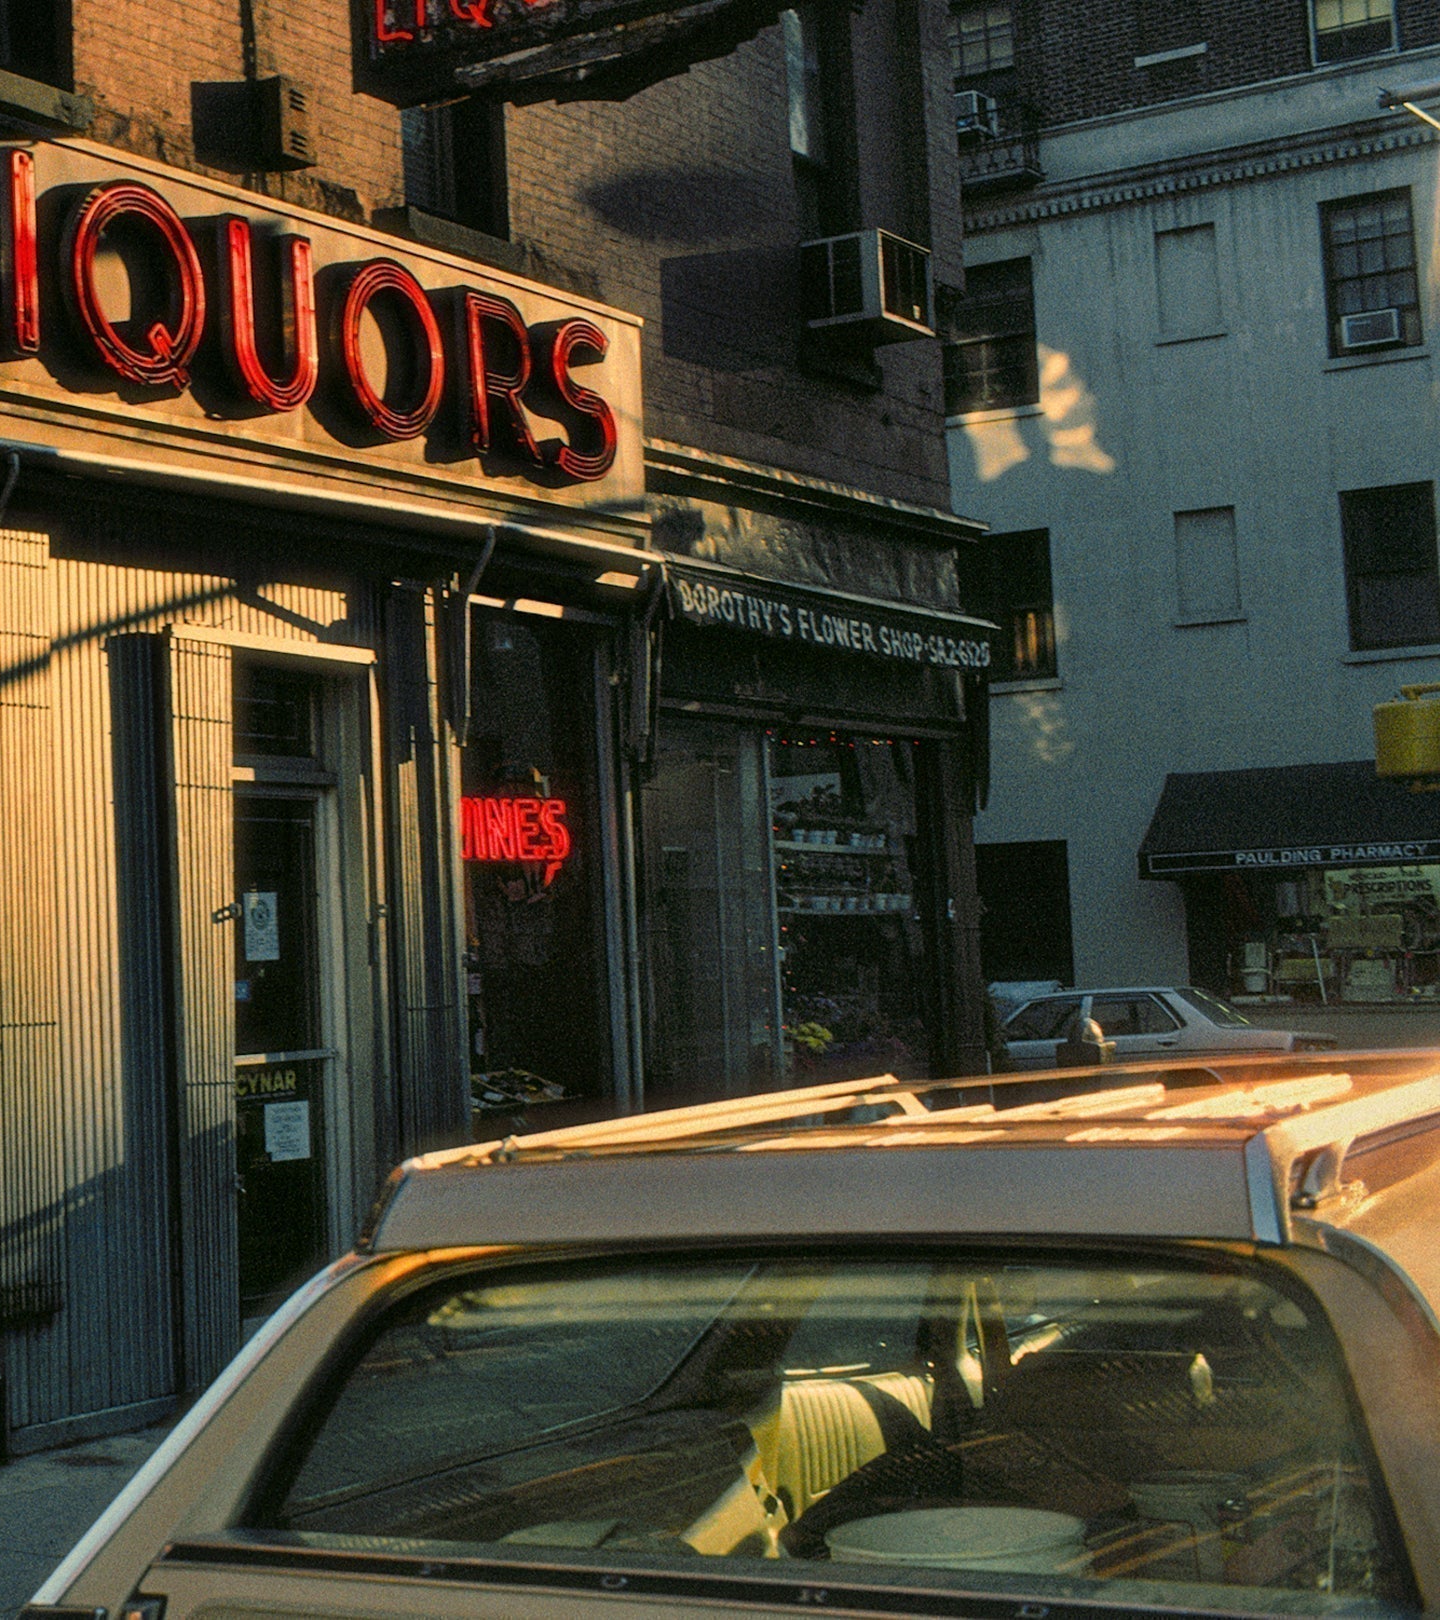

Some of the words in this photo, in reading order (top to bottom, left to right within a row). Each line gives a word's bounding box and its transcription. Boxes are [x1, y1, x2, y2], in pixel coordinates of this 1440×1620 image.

[679, 579, 794, 636] DOROTHY'S
[797, 607, 878, 653] FLOWER
[1234, 850, 1322, 865] PAULDING
[1329, 843, 1429, 860] PHARMACY
[235, 1068, 298, 1097] CYNAR
